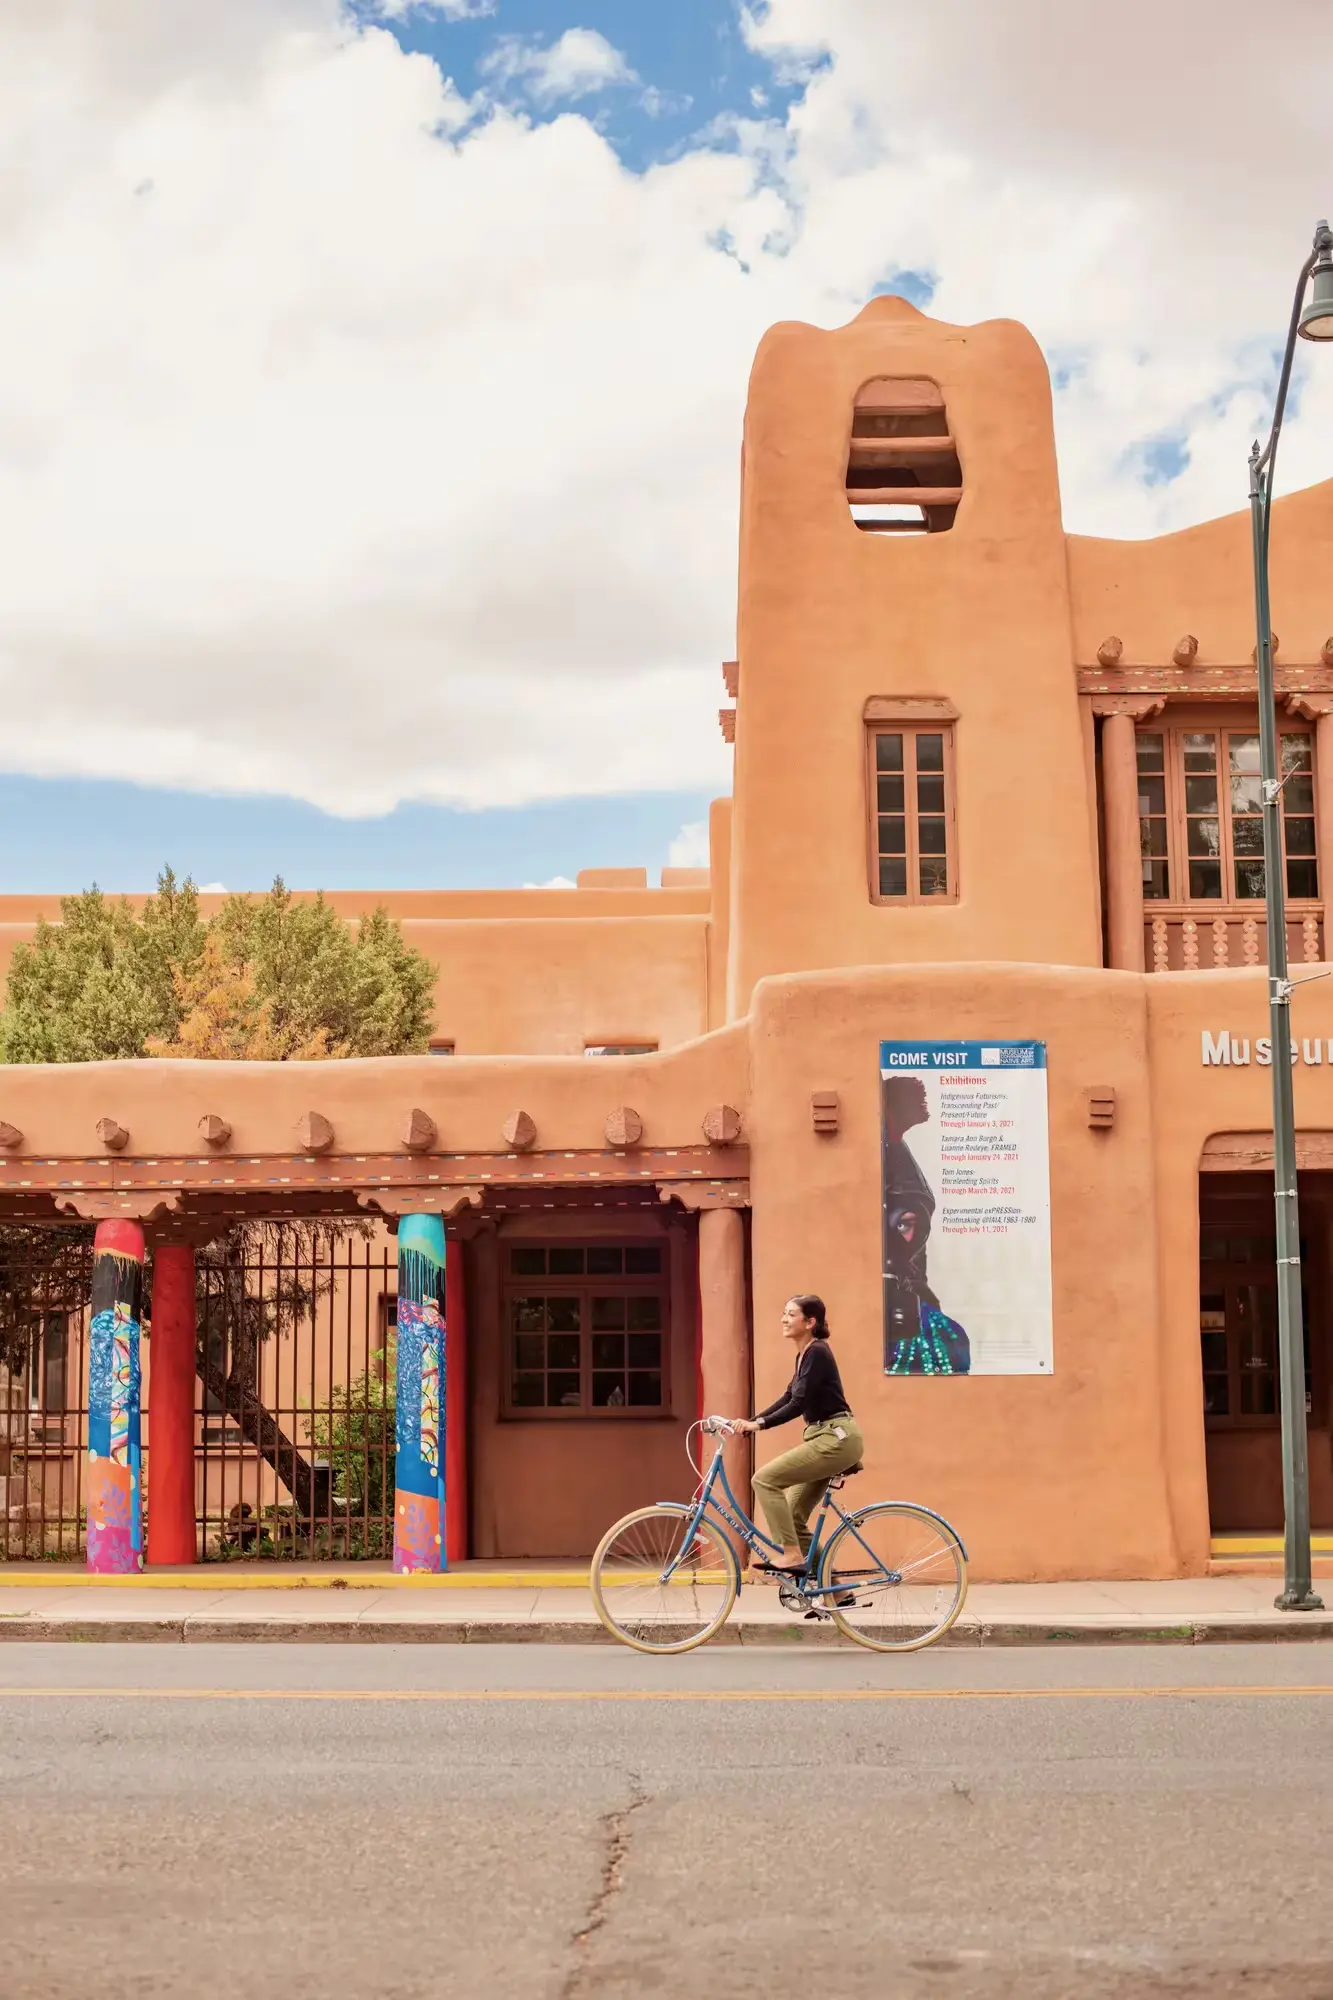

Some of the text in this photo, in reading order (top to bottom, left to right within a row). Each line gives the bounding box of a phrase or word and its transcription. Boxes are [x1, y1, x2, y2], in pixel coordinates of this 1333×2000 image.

[890, 1052, 928, 1066] COME
[932, 1052, 968, 1066] VISIT
[940, 1076, 987, 1085] Exhibitions
[940, 1120, 966, 1128] Through
[941, 1154, 966, 1162] Through
[942, 1216, 980, 1225] Printmaking
[942, 1226, 968, 1234] Through
[716, 1505, 731, 1519] INN
[730, 1520, 739, 1529] OF
[740, 1530, 752, 1544] THE
